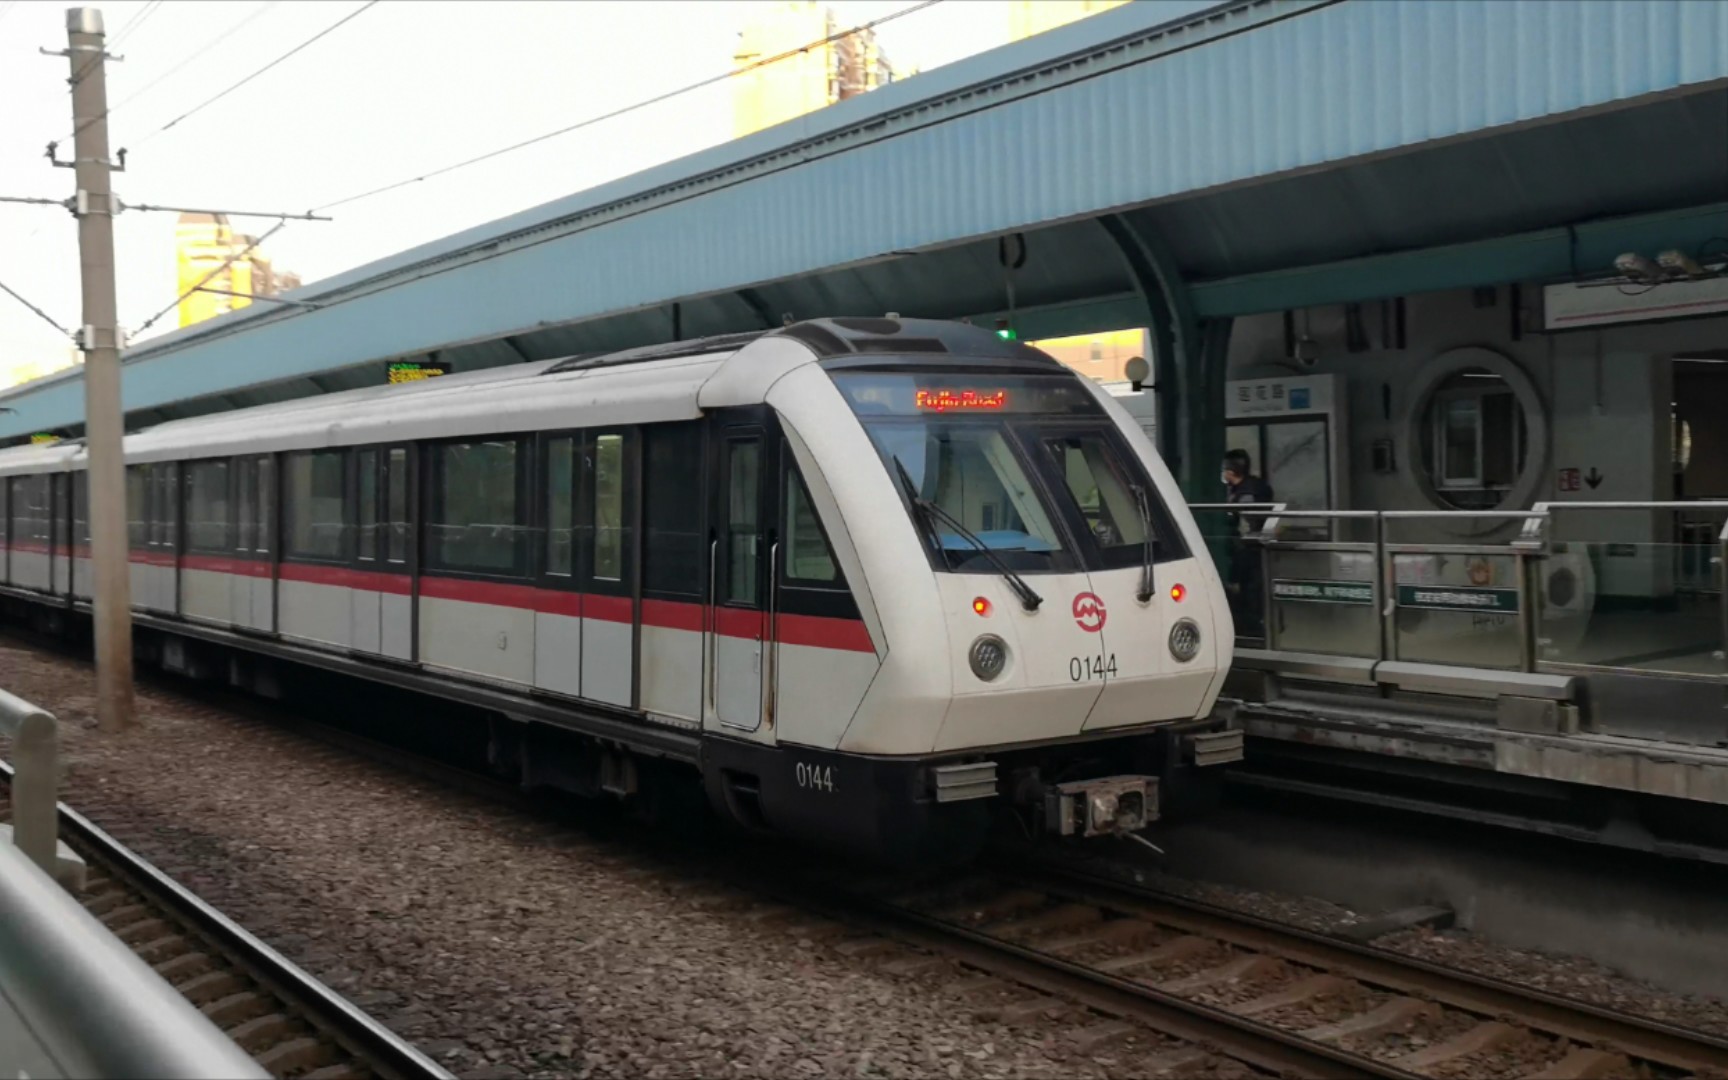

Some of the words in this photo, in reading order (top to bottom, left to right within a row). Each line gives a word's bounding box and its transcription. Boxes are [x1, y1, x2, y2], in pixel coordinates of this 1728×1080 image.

[962, 391, 1004, 408] Road
[1069, 653, 1118, 682] 0144
[796, 761, 834, 793] 0144
